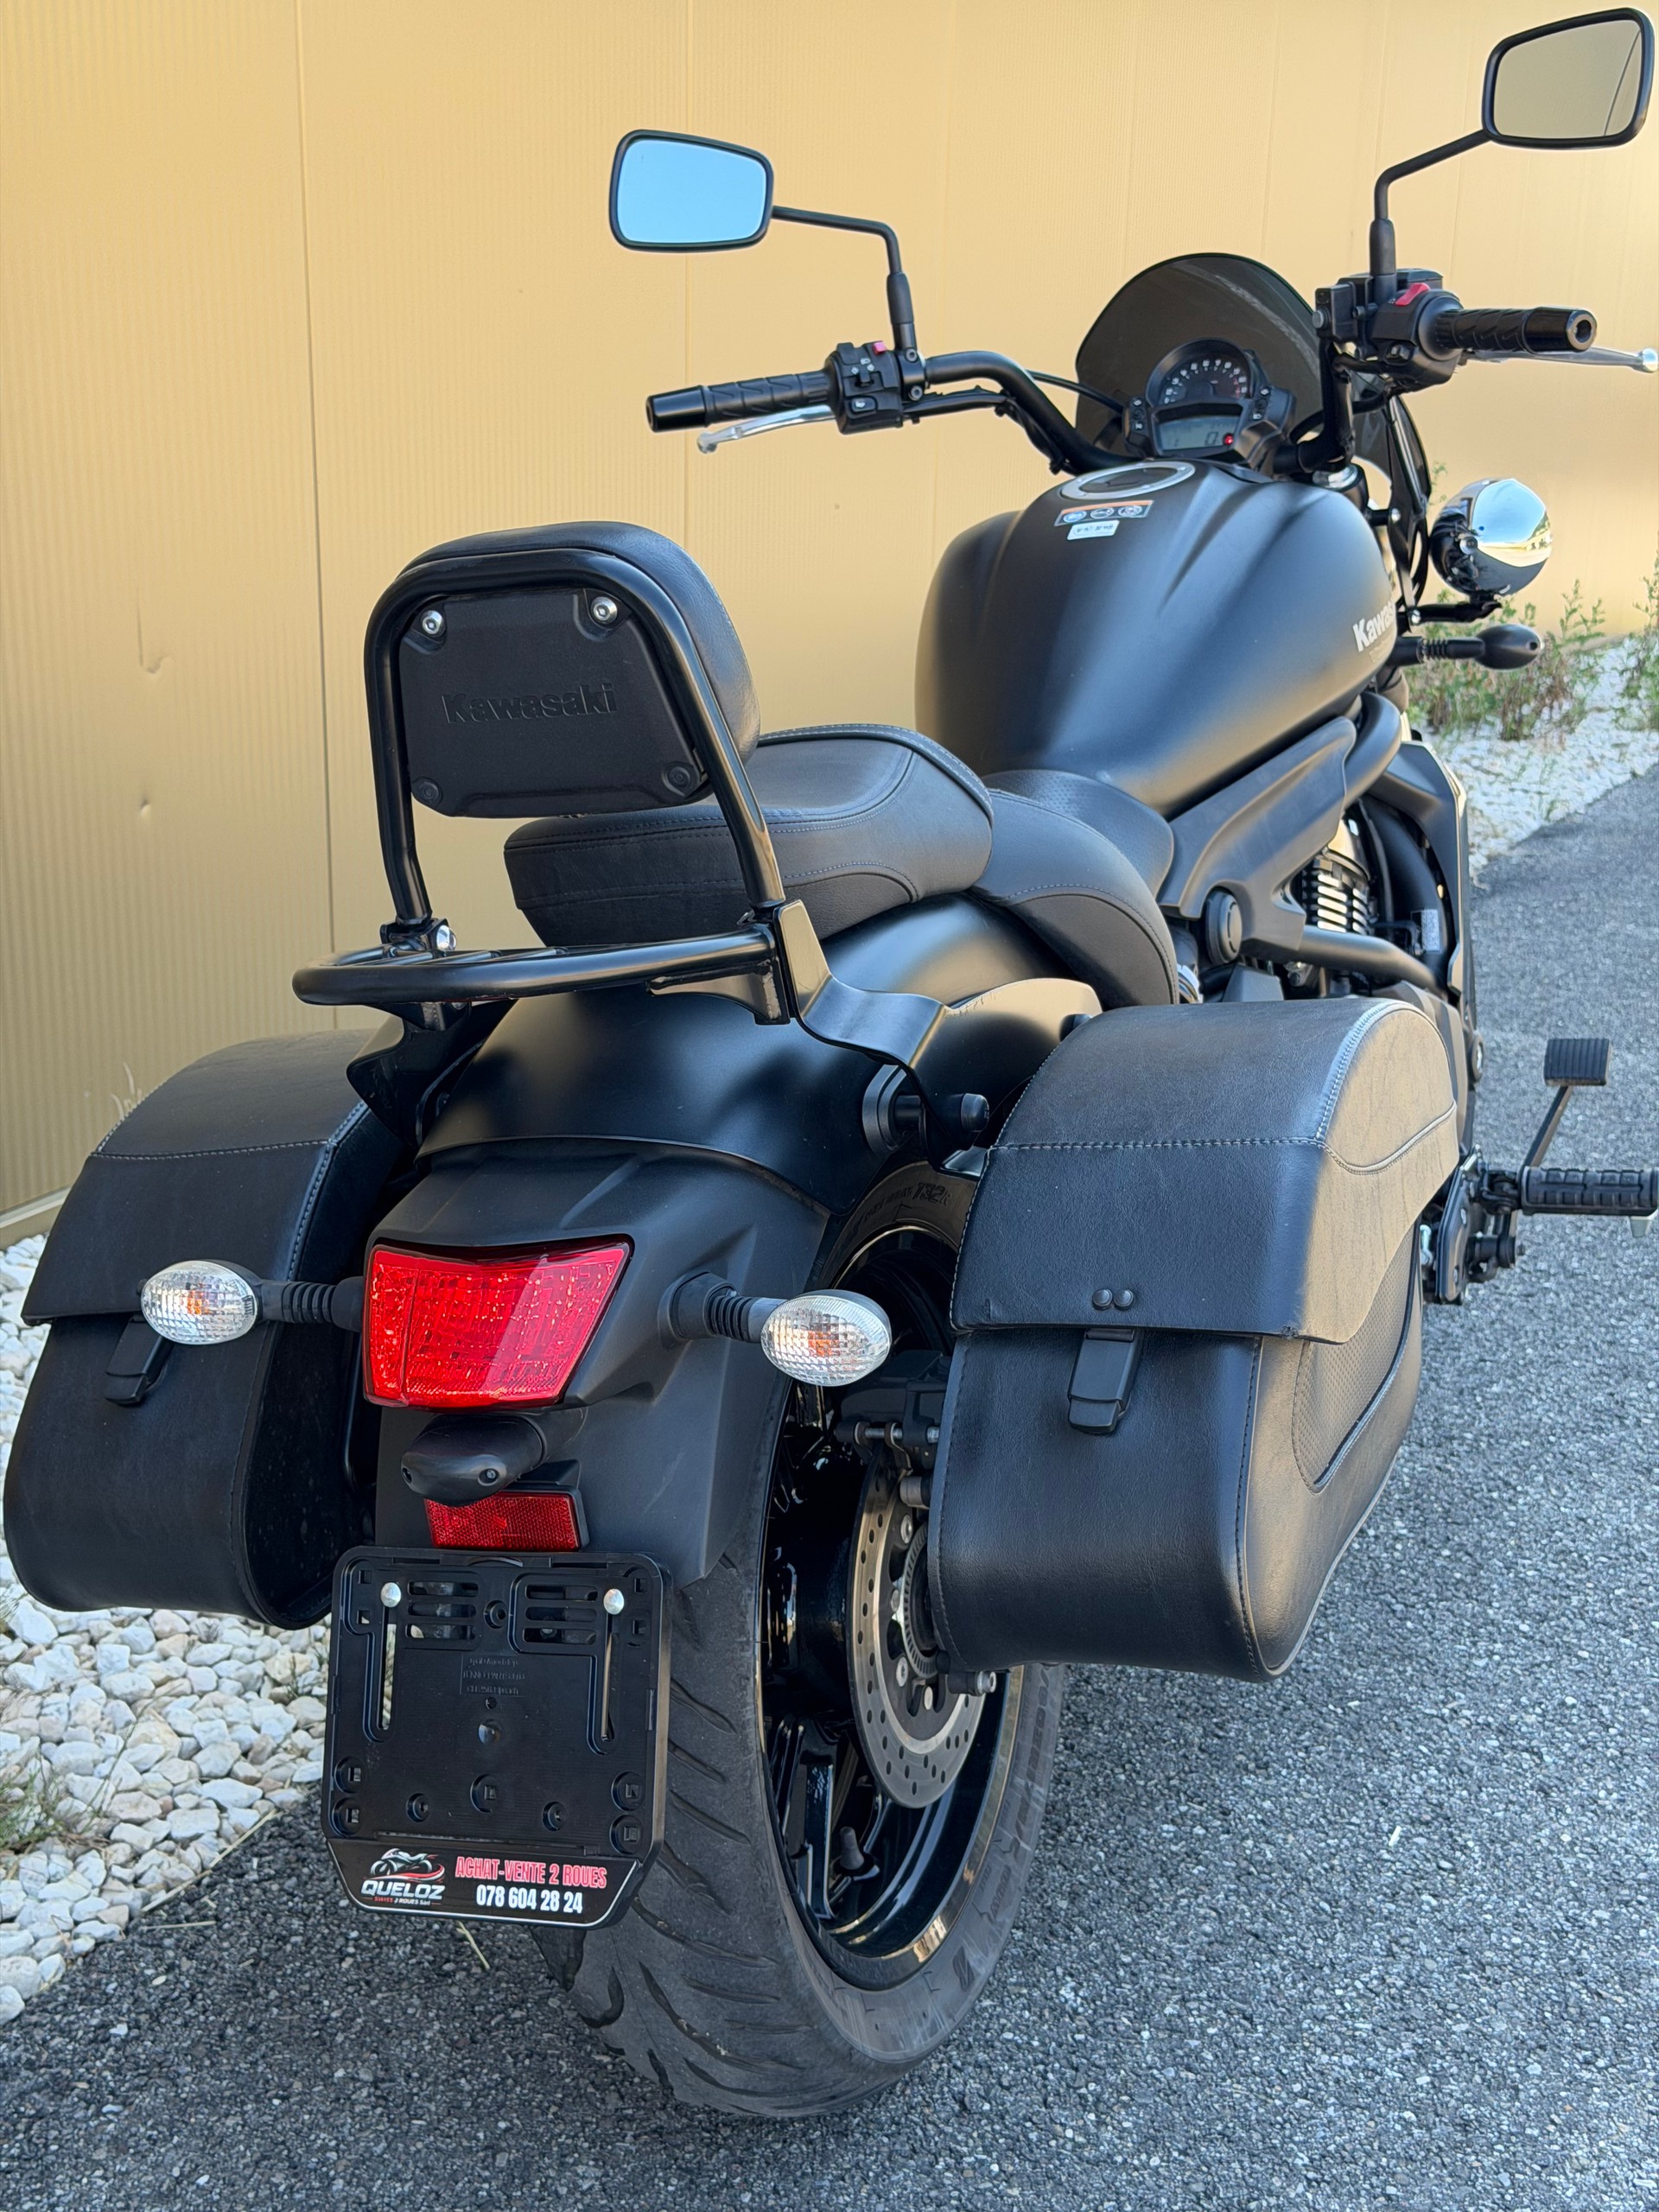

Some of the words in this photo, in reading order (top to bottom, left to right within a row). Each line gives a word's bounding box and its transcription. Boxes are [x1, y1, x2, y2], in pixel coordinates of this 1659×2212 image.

[442, 683, 617, 724] Kawasaki
[455, 1856, 546, 1884] ACHAT-VENTE
[549, 1863, 559, 1885] 2
[563, 1864, 607, 1889] ROUES
[360, 1879, 446, 1900] QUELOZ
[476, 1884, 505, 1907] 078
[508, 1886, 537, 1910] 604
[540, 1889, 560, 1911] 28
[563, 1891, 583, 1914] 24
